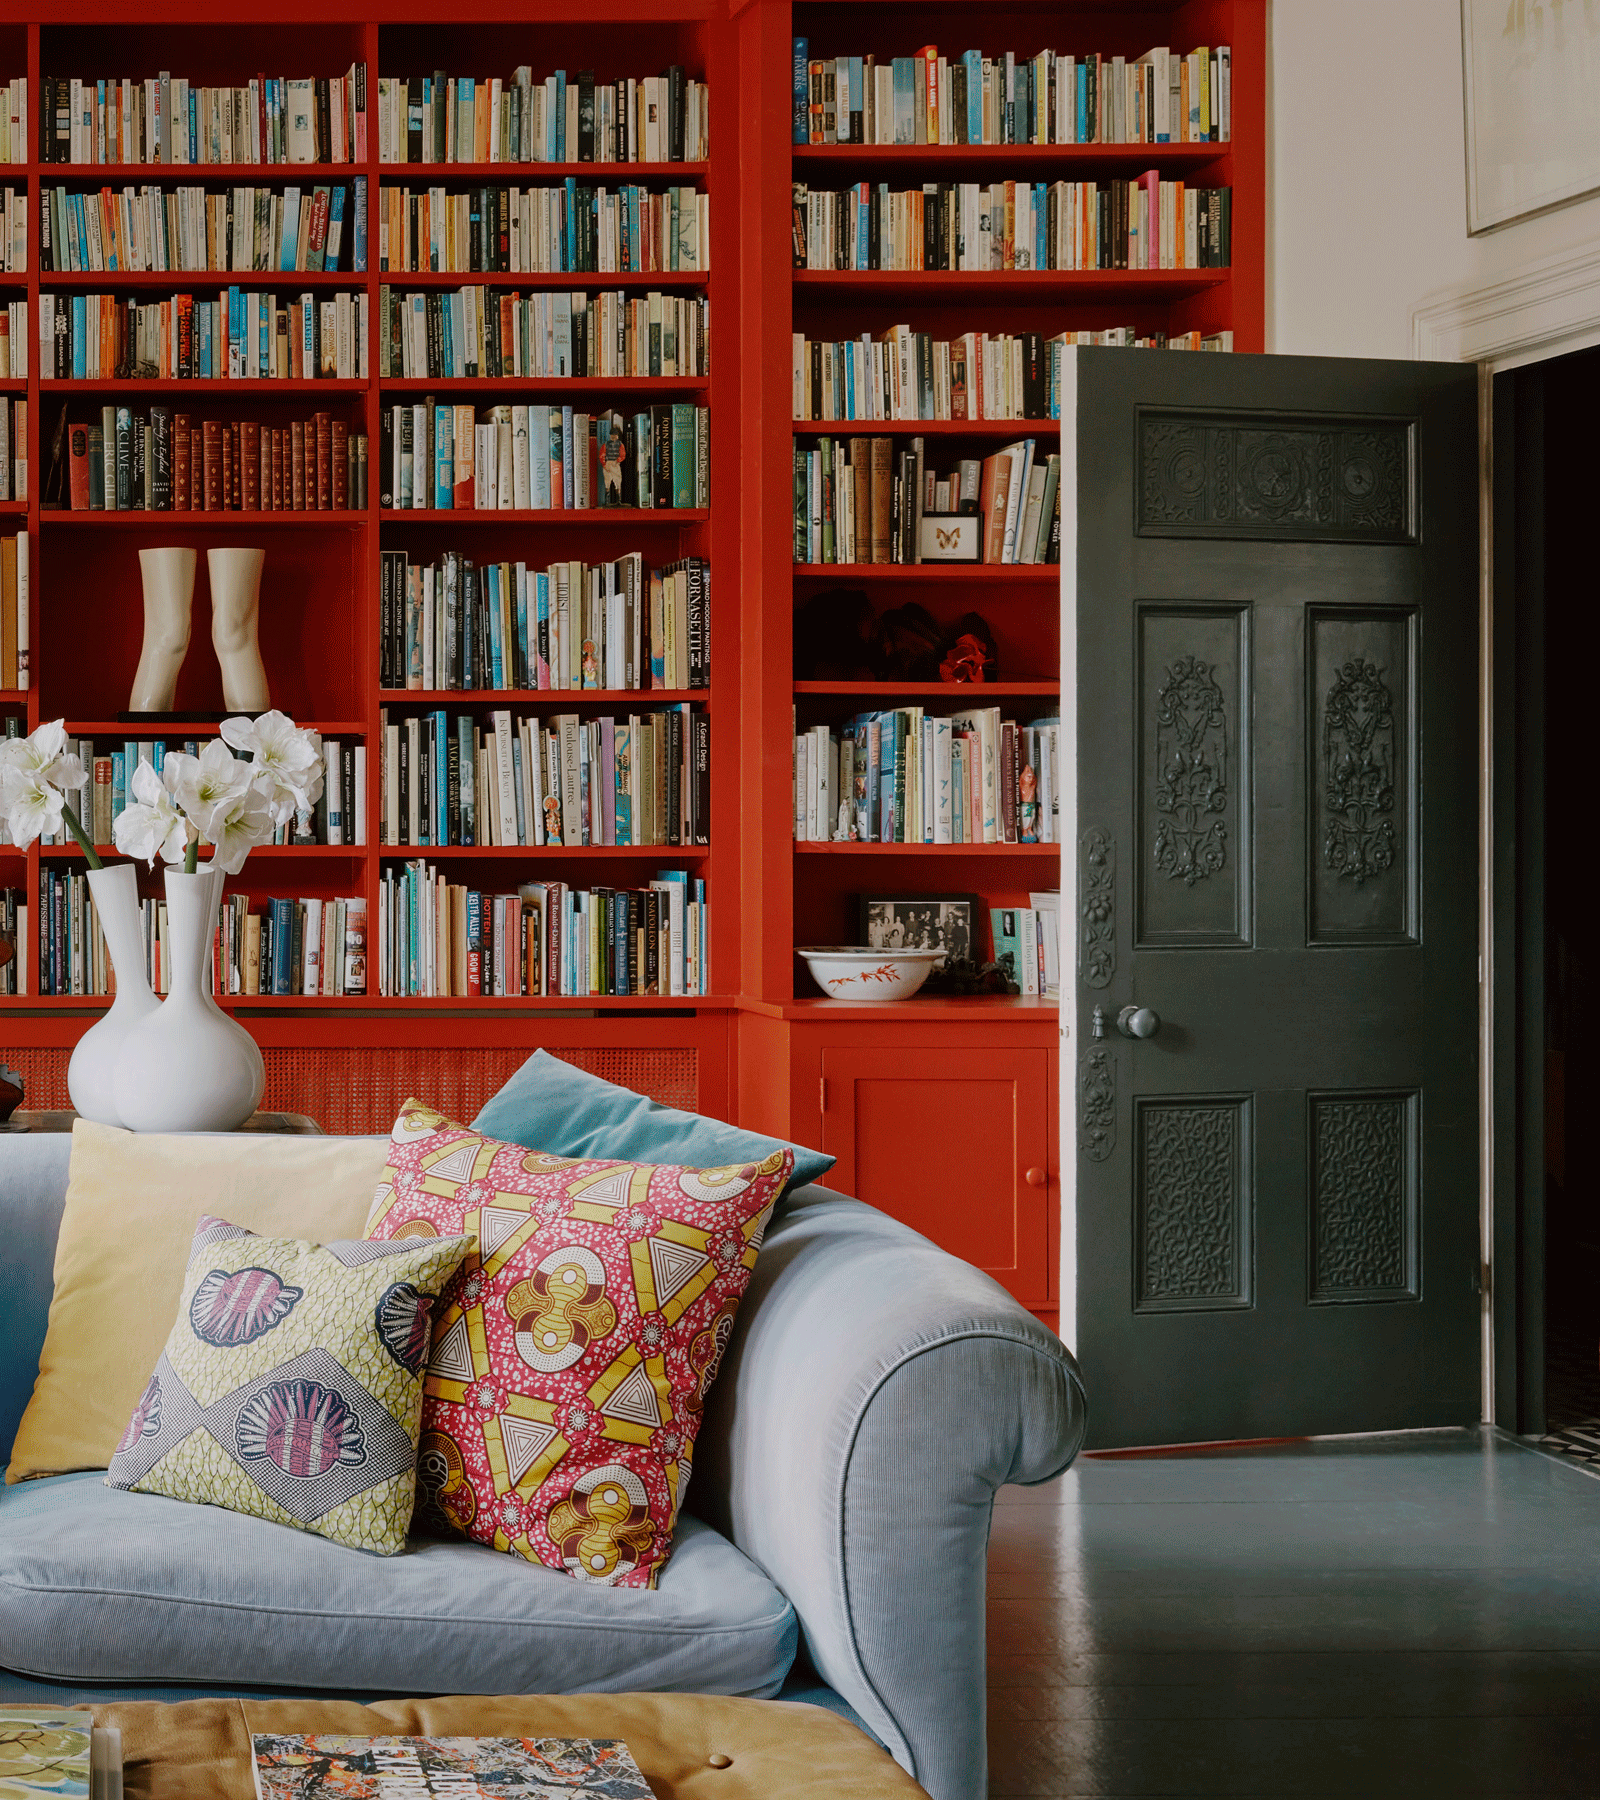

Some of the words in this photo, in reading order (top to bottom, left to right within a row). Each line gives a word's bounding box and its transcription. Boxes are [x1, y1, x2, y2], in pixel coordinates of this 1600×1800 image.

[154, 414, 167, 440] Speaking
[464, 412, 472, 459] WELLINGTON
[662, 417, 670, 438] JOHN
[699, 409, 707, 435] Methods
[105, 442, 114, 471] ERIC
[120, 432, 129, 470] CLIVE
[154, 448, 168, 476] England
[662, 440, 671, 480] SIMPSON
[699, 444, 707, 460] Book
[536, 458, 546, 491] INDIA
[698, 461, 707, 481] Design
[967, 465, 976, 497] REVEAL
[105, 475, 114, 501] GILL
[557, 582, 568, 612] HORST
[689, 568, 701, 650] FORNASETTI
[448, 746, 460, 778] VOGUE
[565, 720, 577, 805] Toulouse-Lautrec
[699, 749, 707, 771] Design
[894, 750, 905, 793] TREES
[468, 894, 479, 914] KEITH
[468, 915, 479, 937] ALLEN
[648, 901, 656, 949] NAPOLEON
[672, 931, 682, 956] BIBLE
[1024, 945, 1033, 965] Boyd
[468, 953, 479, 973] GROW
[550, 951, 559, 981] Treasury
[470, 974, 479, 984] UP
